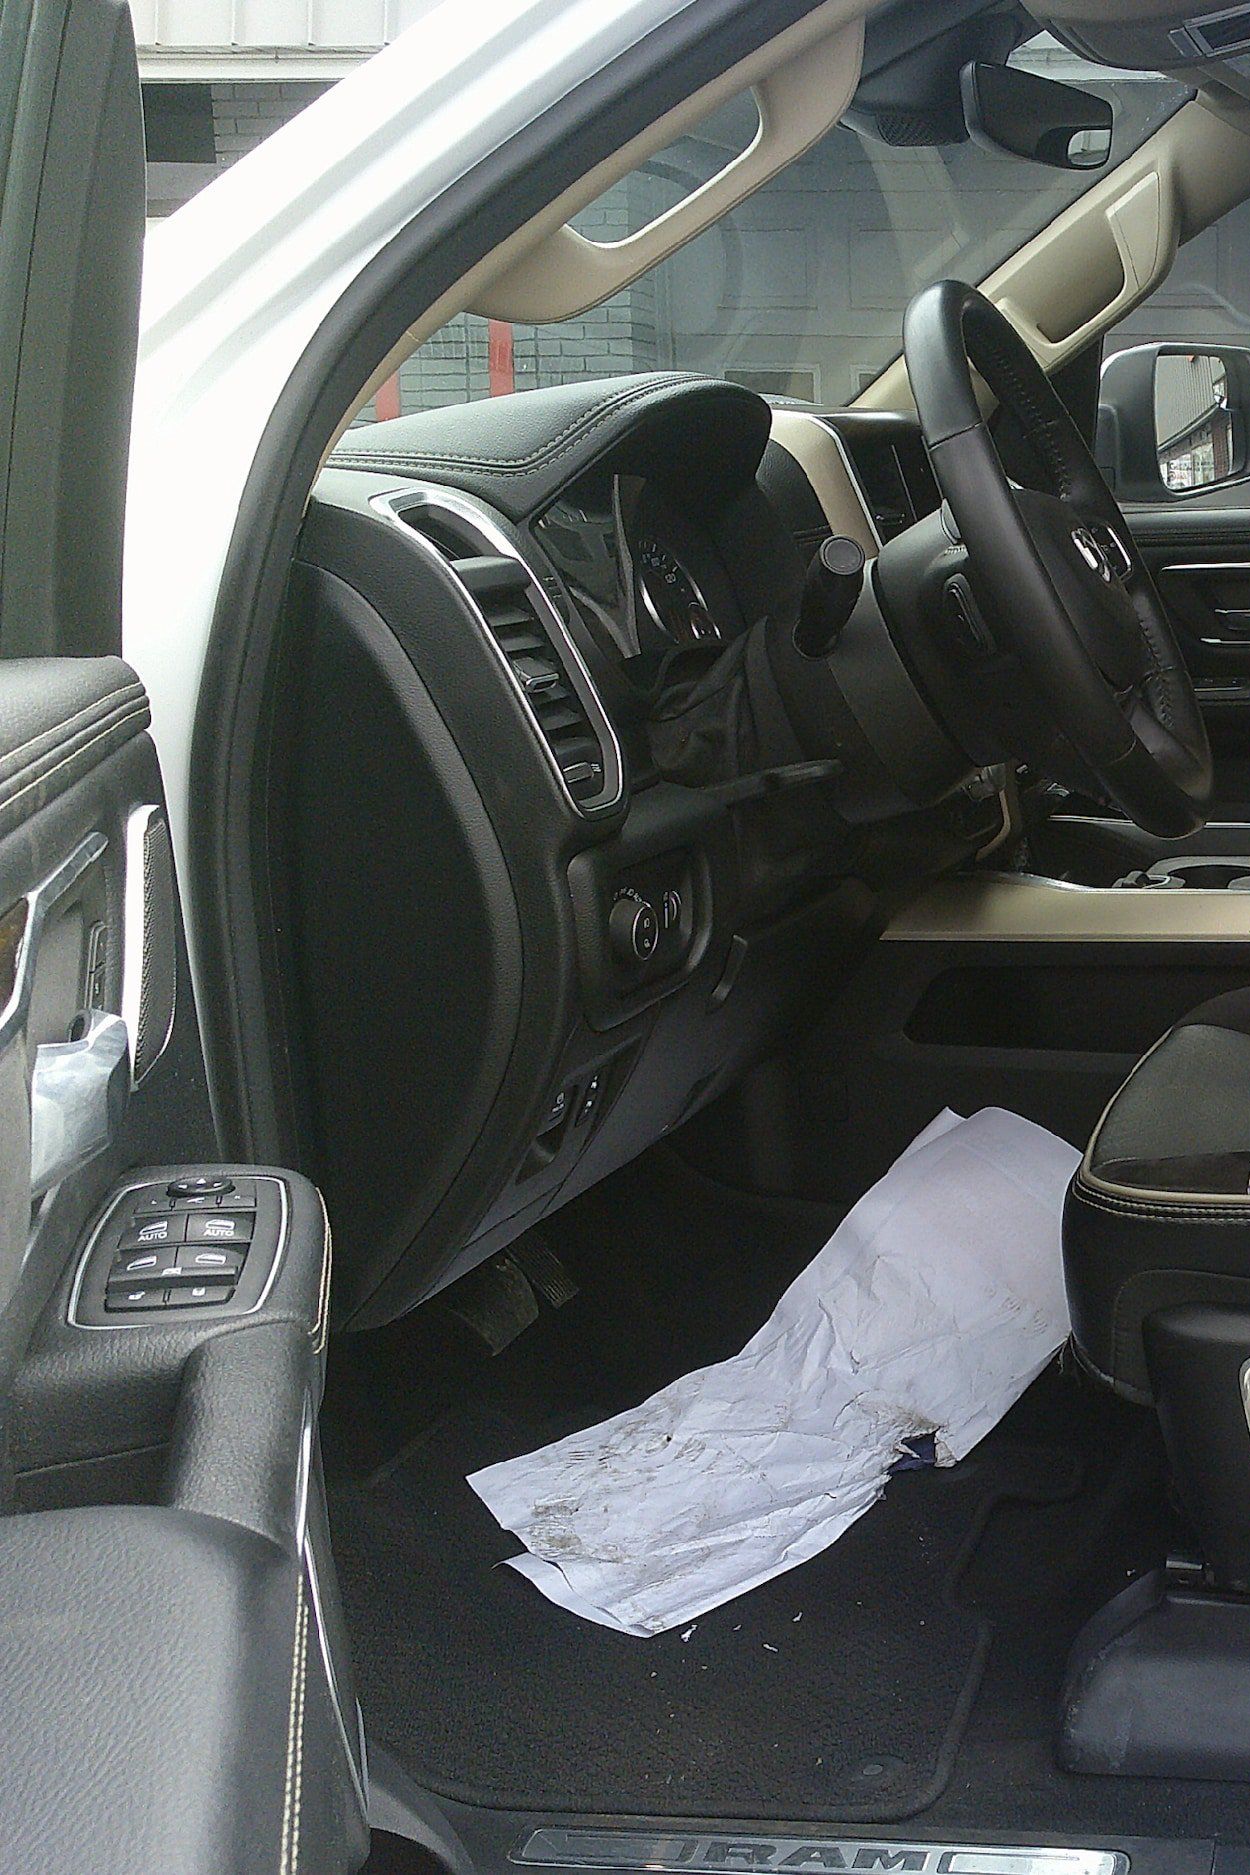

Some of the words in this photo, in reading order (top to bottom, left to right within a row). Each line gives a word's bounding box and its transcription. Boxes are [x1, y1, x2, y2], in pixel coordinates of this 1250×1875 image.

[138, 1231, 168, 1242] AUTO
[203, 1228, 235, 1237] AUTO
[703, 1841, 930, 1871] RAM
